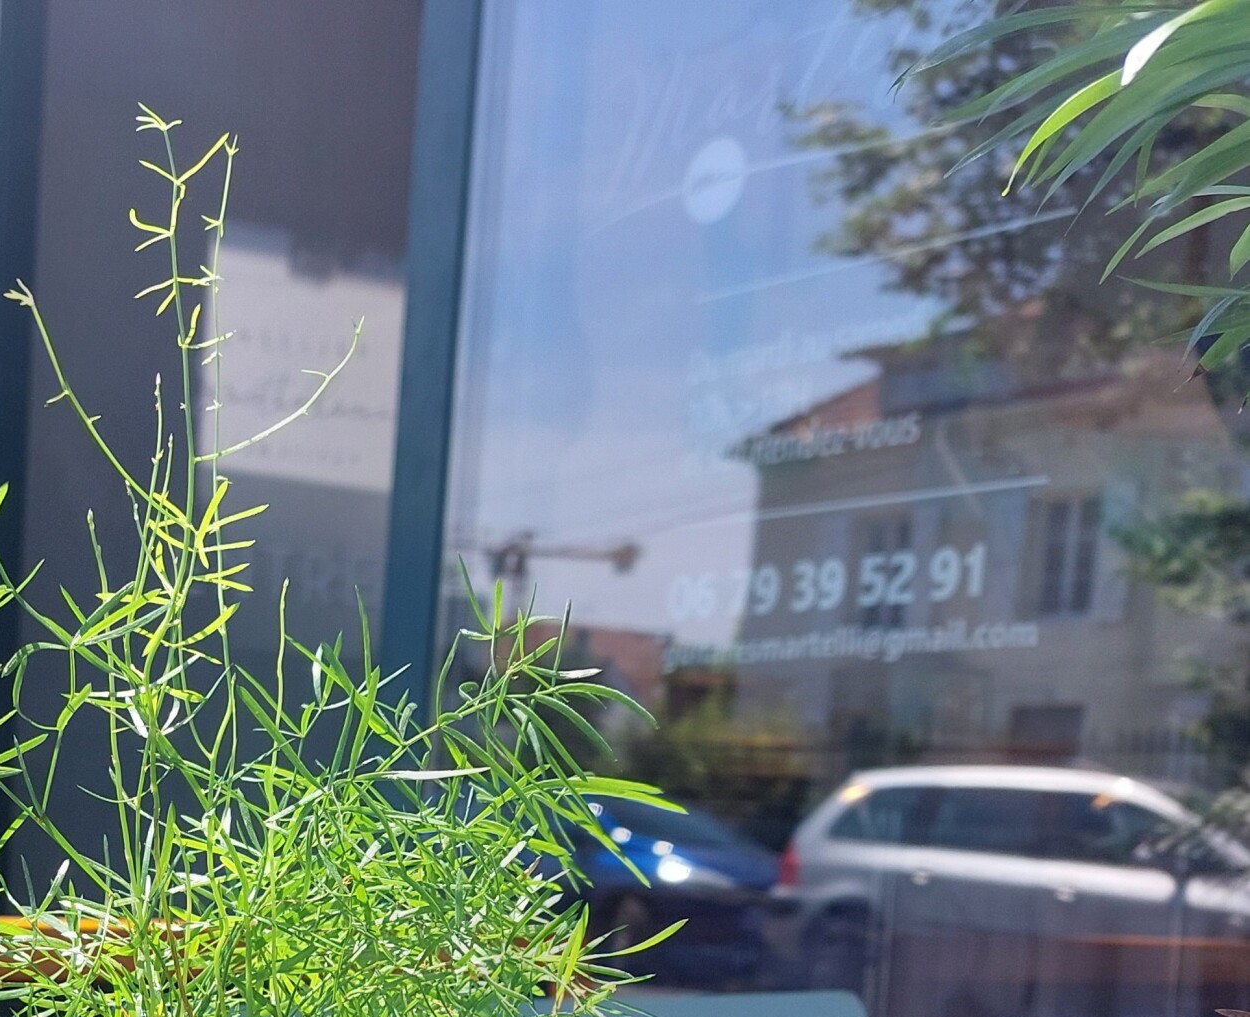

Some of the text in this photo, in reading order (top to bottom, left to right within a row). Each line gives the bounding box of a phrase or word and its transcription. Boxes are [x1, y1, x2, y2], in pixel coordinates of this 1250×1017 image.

[728, 562, 783, 617] 79
[790, 557, 846, 614] 39
[857, 550, 919, 608] 52
[929, 541, 988, 603] 91
